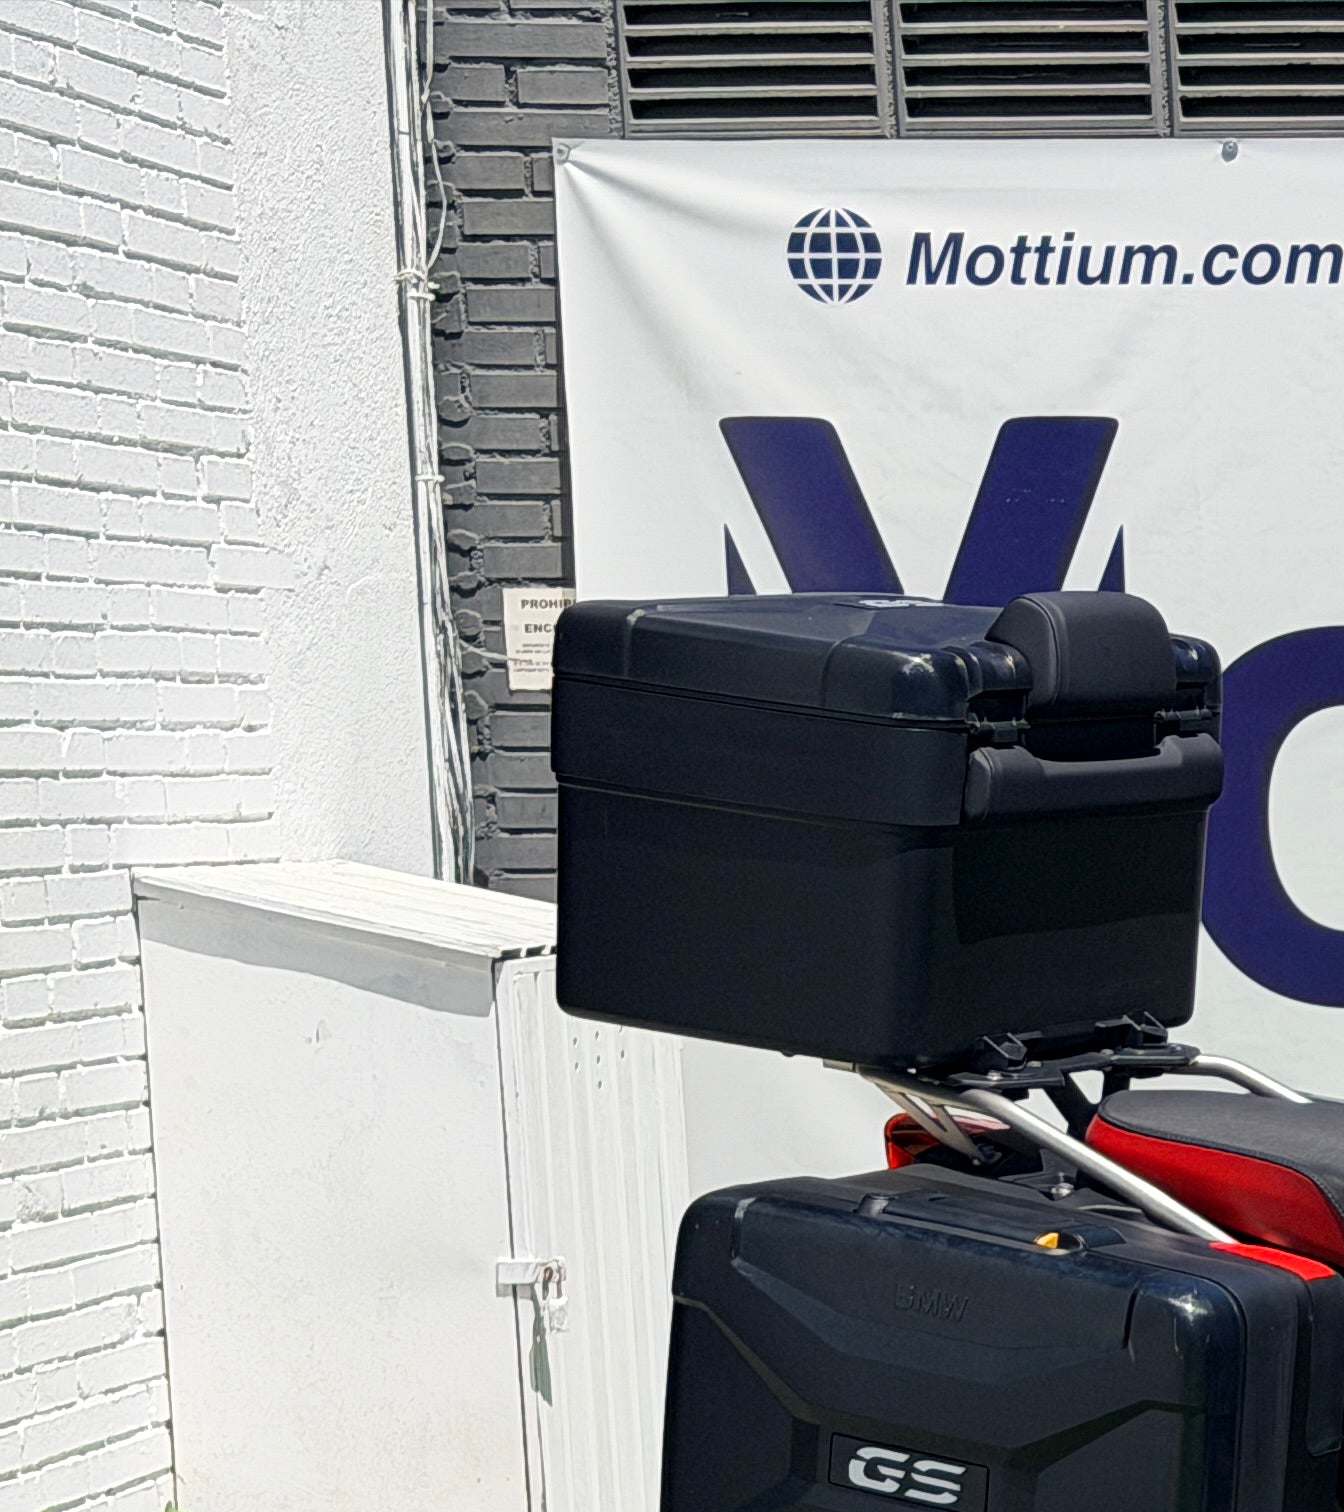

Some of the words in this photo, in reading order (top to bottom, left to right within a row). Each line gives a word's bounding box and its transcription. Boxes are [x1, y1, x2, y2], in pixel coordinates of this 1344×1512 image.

[905, 231, 1344, 286] Mottium.com
[894, 1282, 969, 1323] BMW
[848, 1446, 967, 1505] GS
